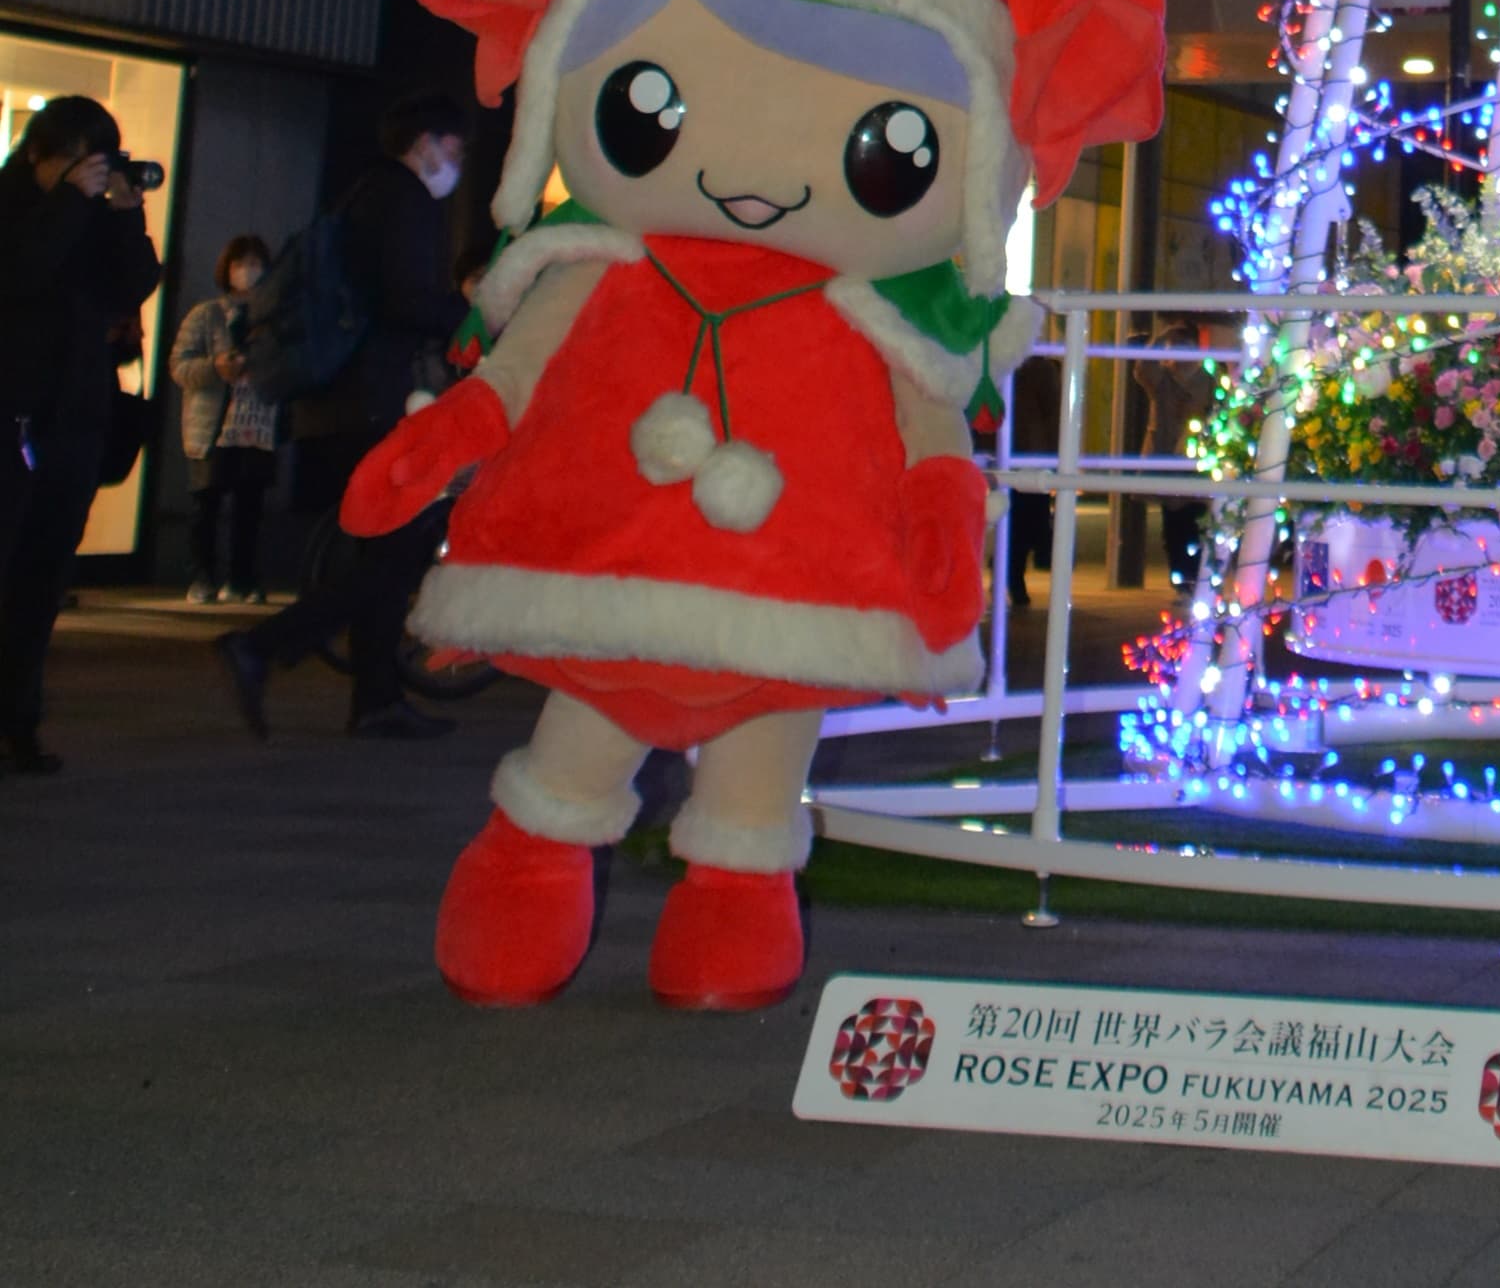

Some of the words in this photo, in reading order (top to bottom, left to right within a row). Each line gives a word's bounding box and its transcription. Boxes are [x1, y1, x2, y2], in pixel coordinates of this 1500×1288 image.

[964, 1002, 1082, 1044] 第20回
[1093, 1009, 1455, 1067] 世界バラ会議福山大会
[953, 1052, 1059, 1089] ROSE
[1066, 1059, 1169, 1095] EXPO
[1181, 1073, 1354, 1108] FUKUYAMA
[1365, 1084, 1449, 1114] 2025
[1096, 1102, 1283, 1138] 2025年5月開催
